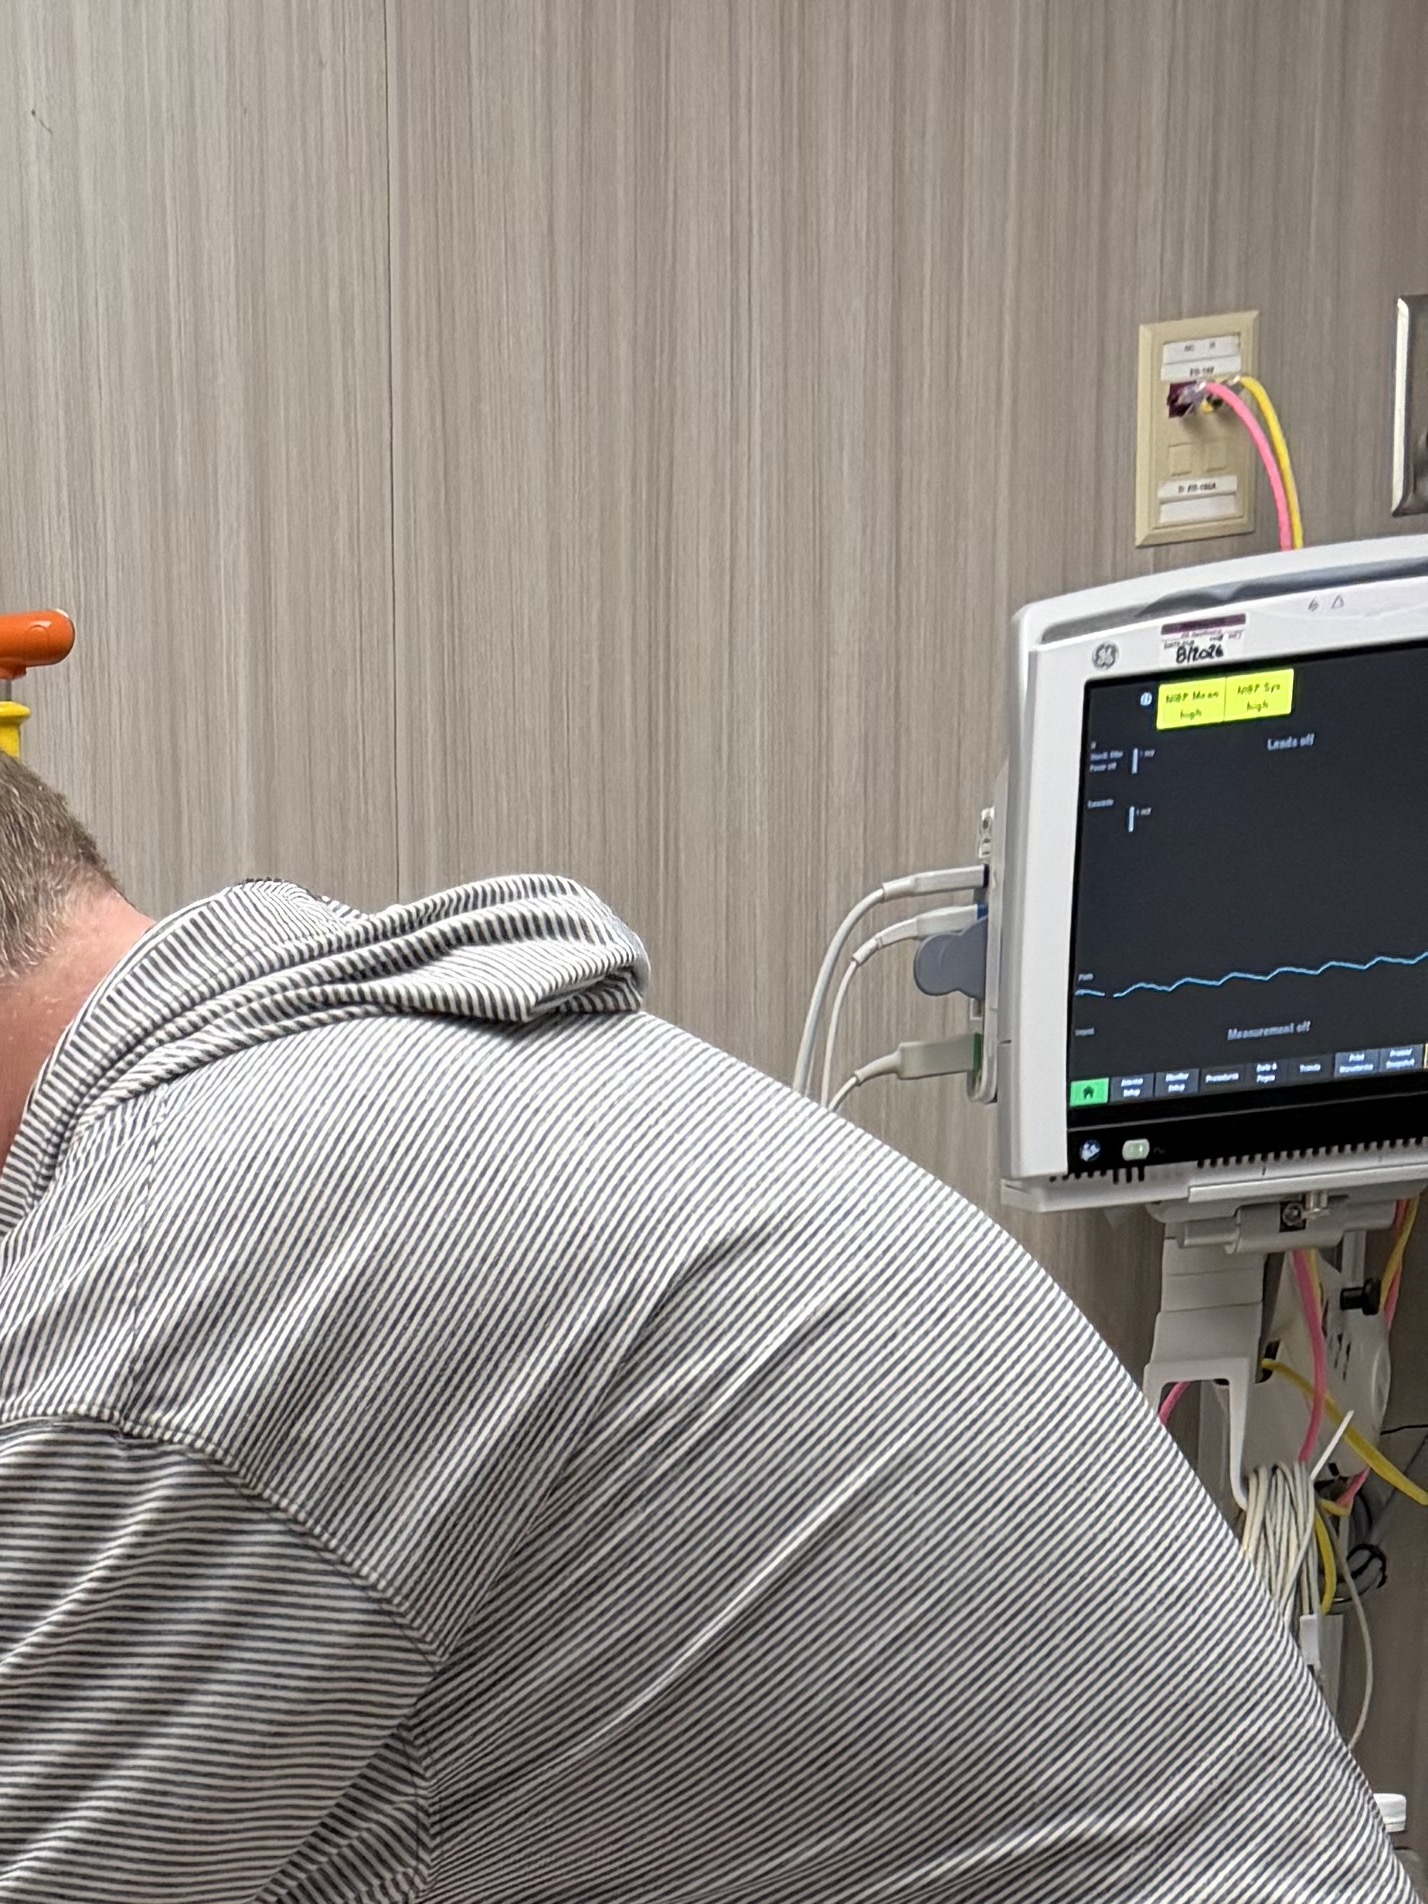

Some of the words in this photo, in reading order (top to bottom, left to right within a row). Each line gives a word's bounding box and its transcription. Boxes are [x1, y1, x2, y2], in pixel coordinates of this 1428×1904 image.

[1267, 736, 1298, 751] Leads
[1299, 733, 1315, 747] off
[1296, 1020, 1311, 1033] off
